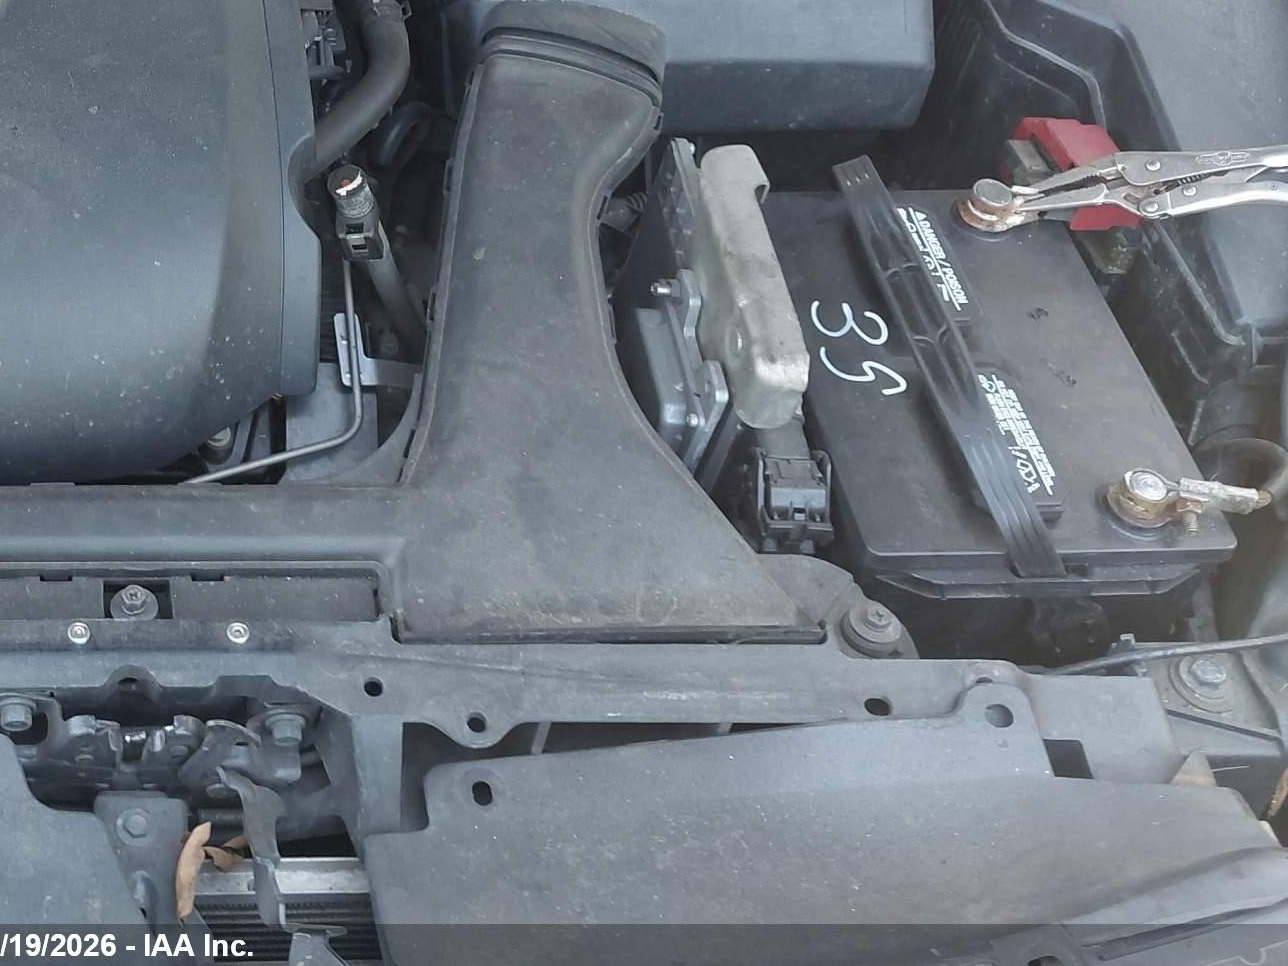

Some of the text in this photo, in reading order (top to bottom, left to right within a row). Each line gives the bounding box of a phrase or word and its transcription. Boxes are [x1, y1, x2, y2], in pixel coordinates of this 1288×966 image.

[918, 220, 946, 260] DANGER
[941, 267, 969, 304] POISON
[811, 300, 907, 396] 35
